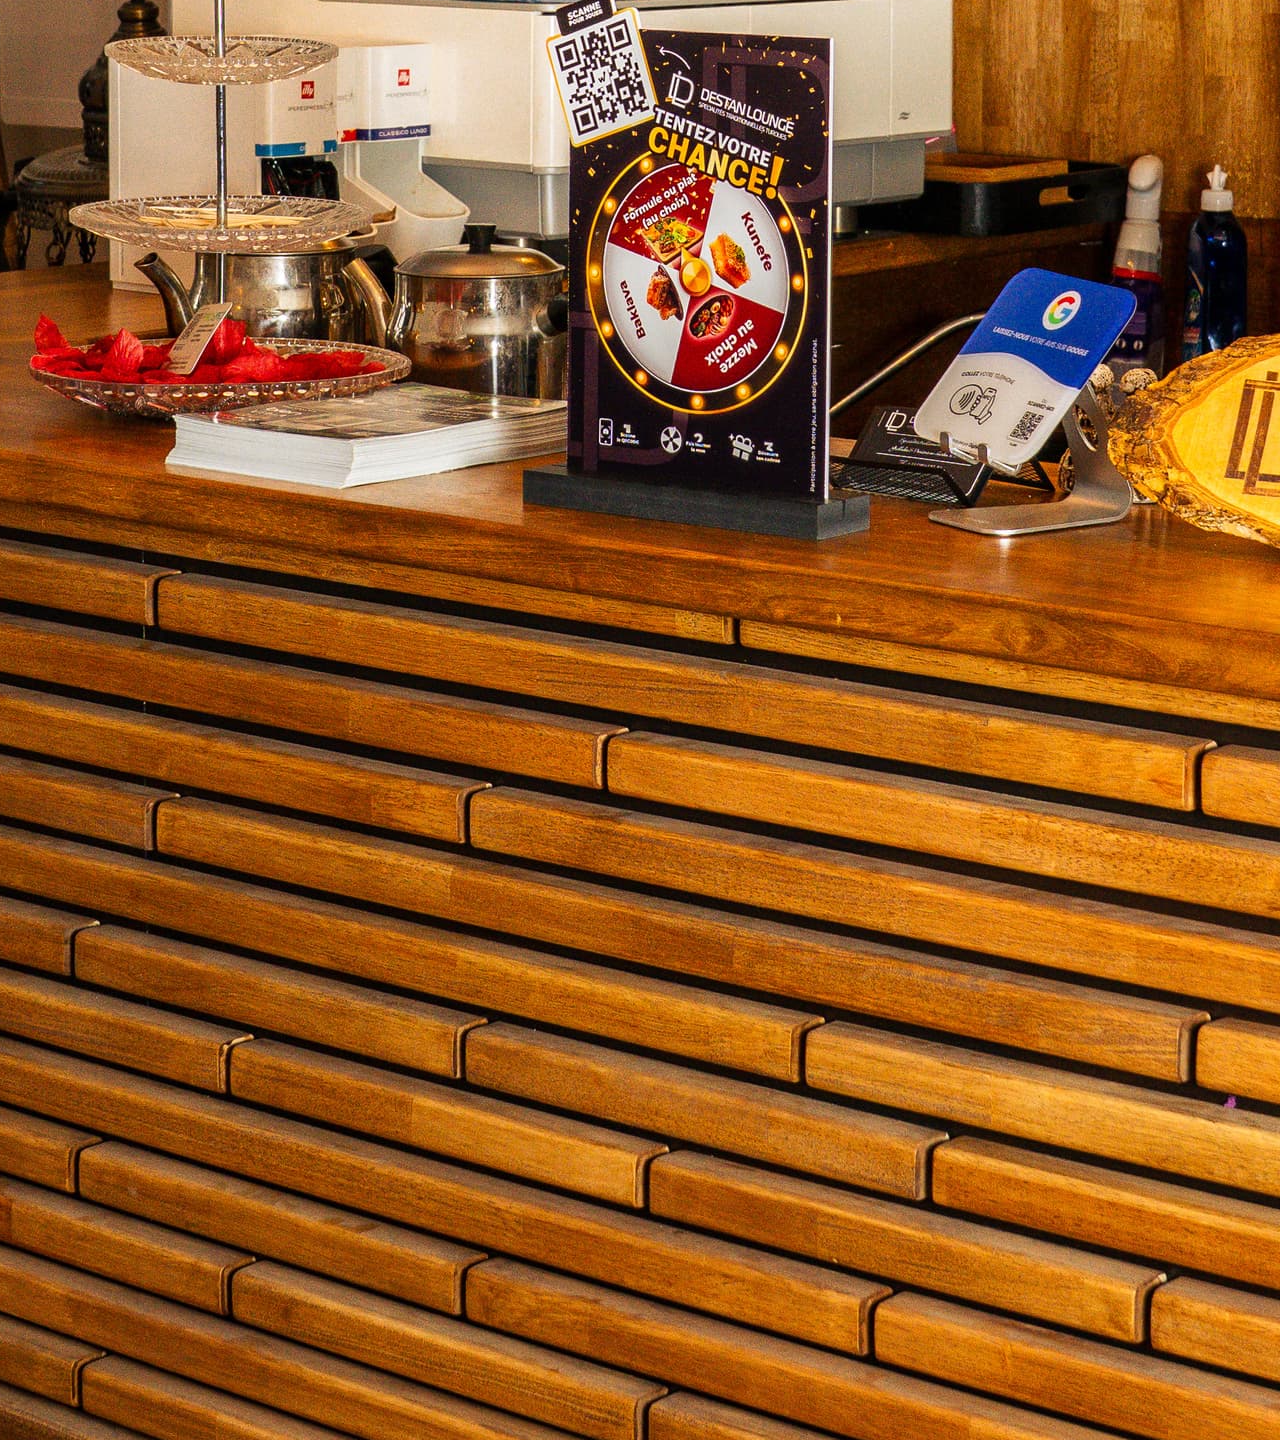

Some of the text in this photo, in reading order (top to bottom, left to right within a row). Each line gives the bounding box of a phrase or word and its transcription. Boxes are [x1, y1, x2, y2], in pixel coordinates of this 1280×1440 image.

[567, 1, 601, 20] SCANNE
[569, 16, 585, 27] POUR
[302, 83, 314, 97] illy
[701, 88, 795, 135] DESTAN LOUNGE
[379, 129, 409, 137] CLASSICO
[654, 106, 771, 167] TENTEZ VOTRE
[649, 126, 784, 200] CHANCE!
[623, 173, 698, 224] Formule ou plat
[642, 193, 690, 230] (au choix)
[740, 211, 773, 272] Kunefe
[620, 280, 647, 340] Baklava
[705, 319, 755, 367] au choix
[719, 338, 759, 374] Mezze
[993, 326, 1030, 341] LAISSEZ-NOUS
[1066, 346, 1089, 357] GOOGLE
